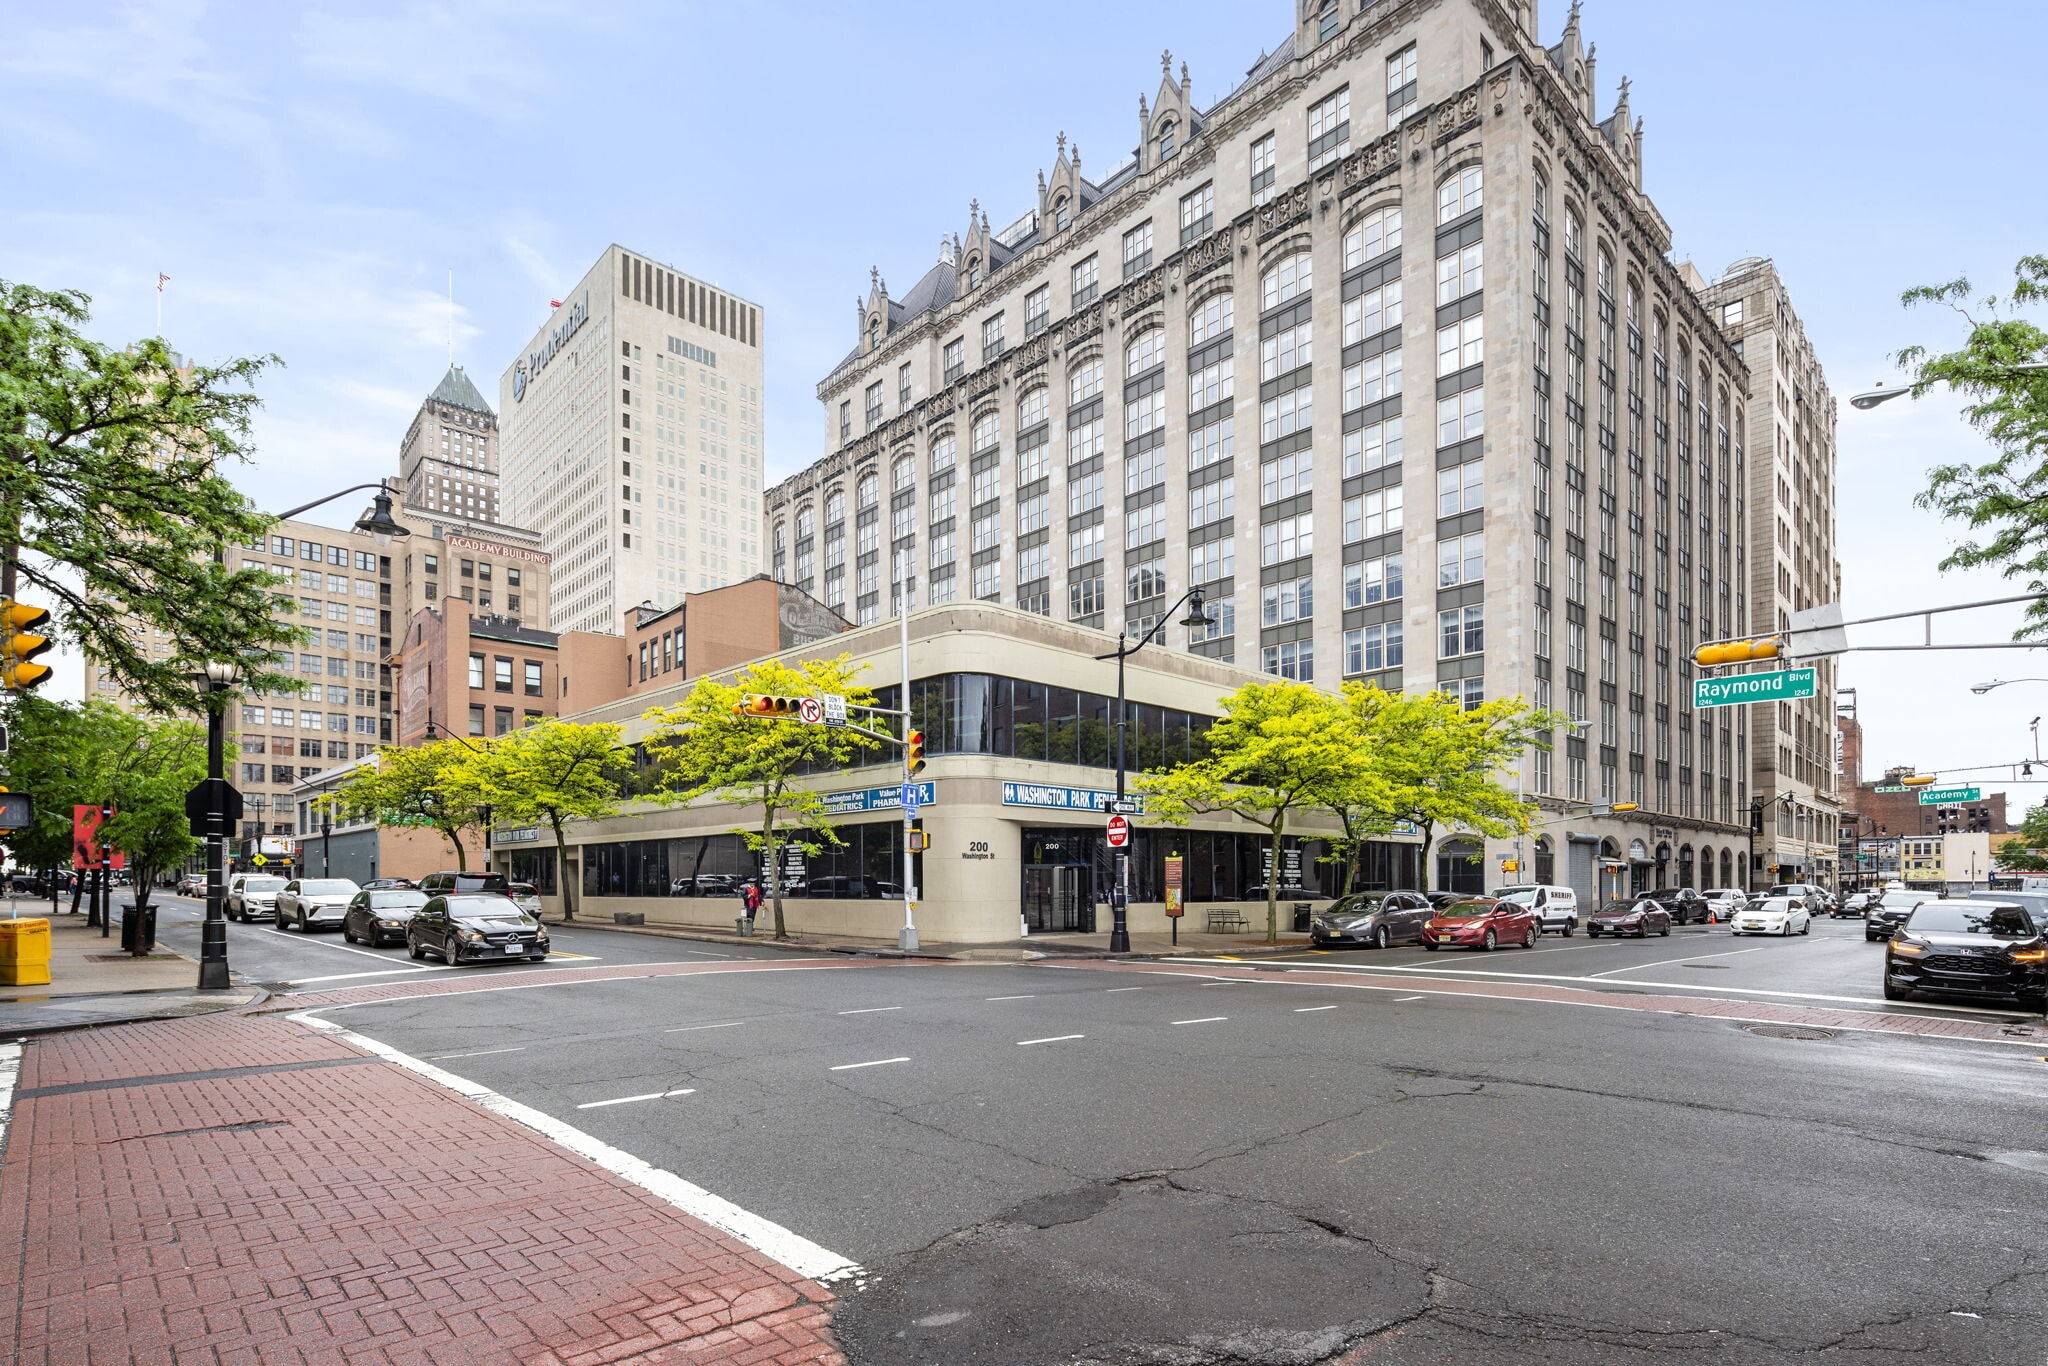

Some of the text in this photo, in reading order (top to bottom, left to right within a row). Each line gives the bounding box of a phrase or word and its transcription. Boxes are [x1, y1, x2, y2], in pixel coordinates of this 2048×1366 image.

[528, 288, 589, 383] Prudential
[451, 537, 547, 564] ACADEMY BUILDING
[1698, 672, 1811, 699] Raymond Blvd
[1794, 689, 1810, 697] 1247
[828, 703, 842, 711] BLOCK
[1698, 698, 1713, 706] 1246
[852, 791, 865, 801] Park
[879, 789, 897, 798] Value
[906, 788, 916, 804] H
[1016, 785, 1068, 806] WASHINGTON
[1070, 790, 1091, 808] PARK
[1922, 791, 1969, 801] Academy
[969, 841, 989, 852] 200
[961, 852, 995, 861] Washington St
[1550, 891, 1573, 899] SHERIFF
